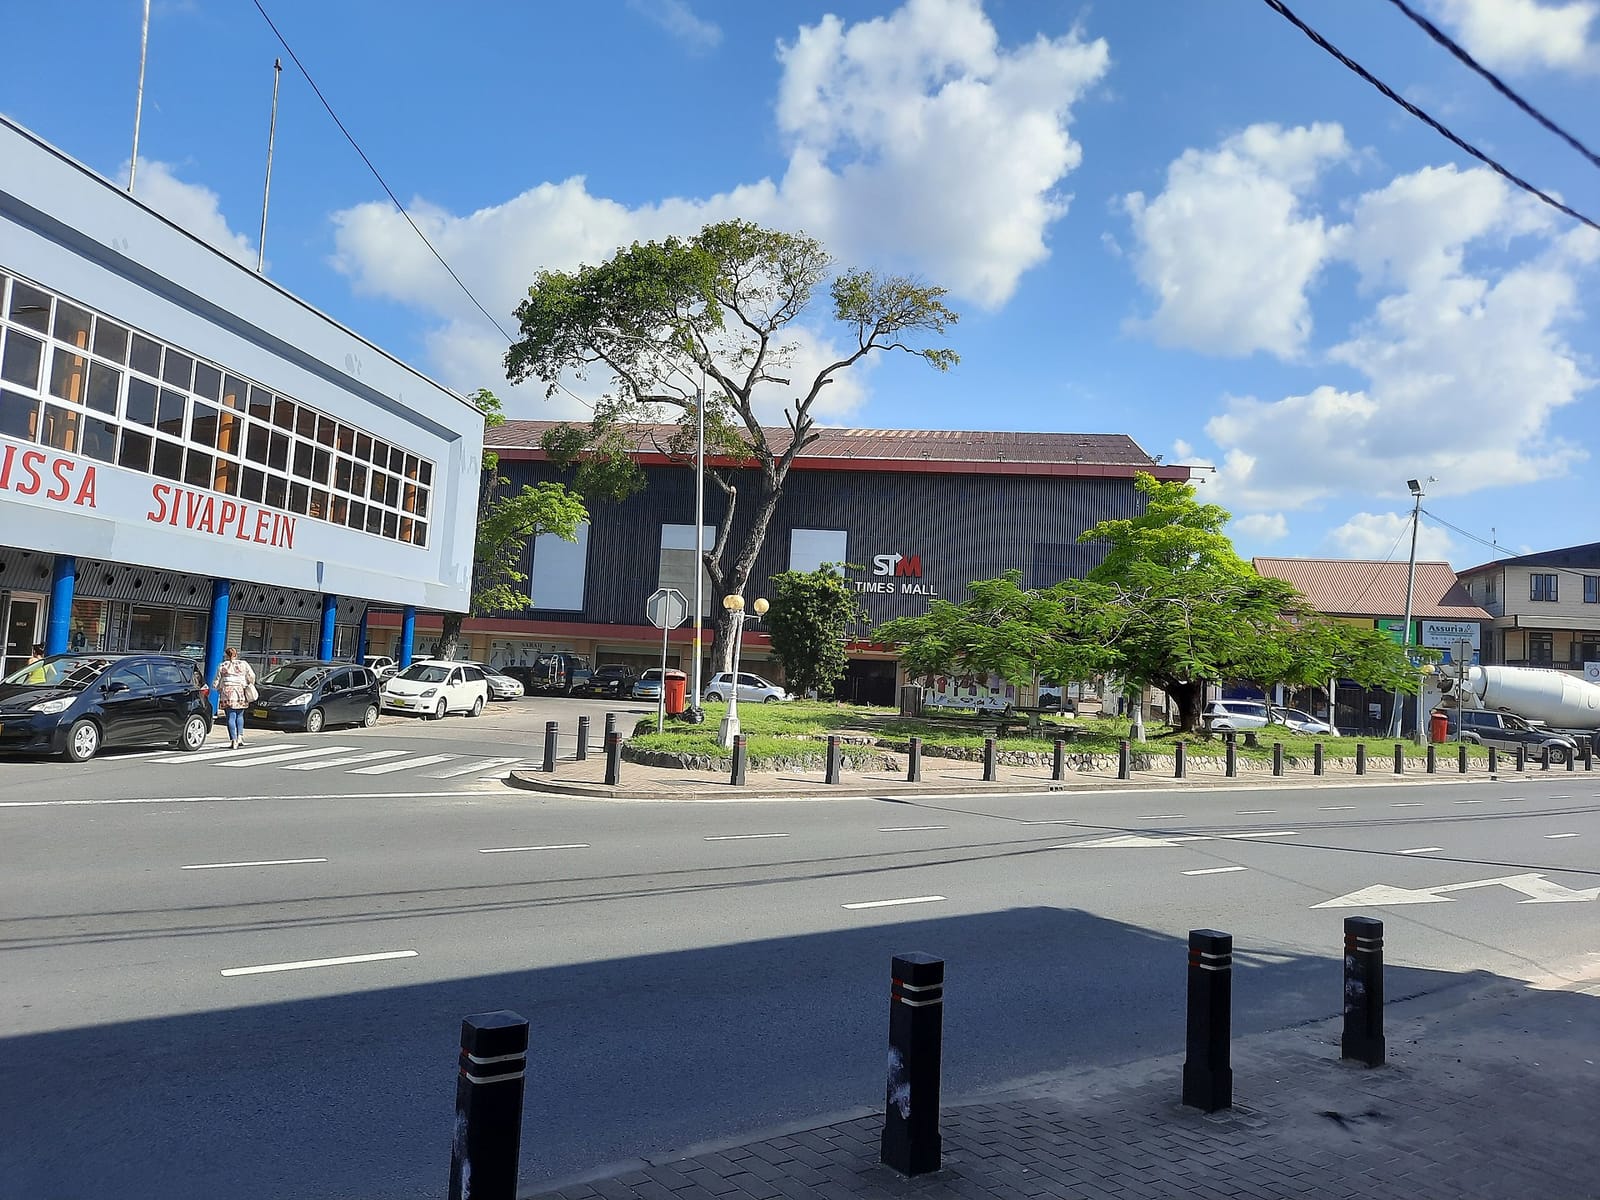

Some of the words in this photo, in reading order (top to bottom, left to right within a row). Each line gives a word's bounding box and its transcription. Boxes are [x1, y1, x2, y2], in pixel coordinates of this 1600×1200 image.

[147, 483, 297, 549] SIVAPLEIN
[873, 552, 922, 577] STM
[855, 581, 895, 594] TIMES
[901, 583, 938, 596] MALL
[1428, 624, 1464, 633] Assuria
